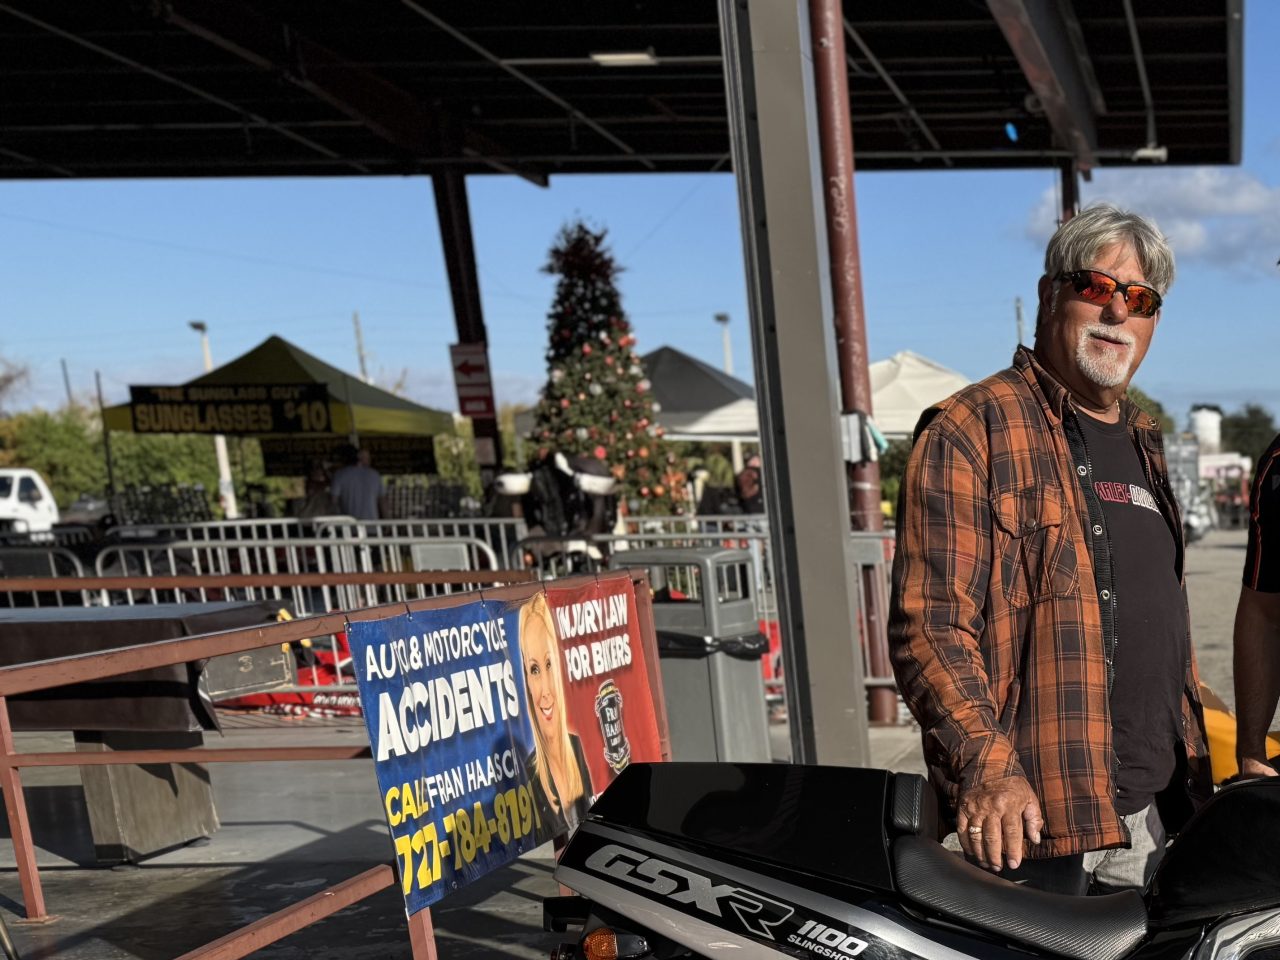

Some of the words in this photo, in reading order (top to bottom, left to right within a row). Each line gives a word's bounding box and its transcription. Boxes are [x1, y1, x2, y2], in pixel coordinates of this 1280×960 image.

[135, 403, 274, 432] SUNGLASSES
[283, 401, 328, 431] $10
[603, 593, 628, 629] LAW
[365, 637, 410, 682] AUTO
[409, 635, 424, 671] &
[423, 617, 508, 668] MOTORCYCLE
[564, 644, 593, 682] FOR
[590, 633, 632, 675] BIKERS
[377, 660, 519, 762] ACCIDENTS
[385, 776, 429, 827] CALL
[425, 766, 465, 808] FRAN
[465, 747, 520, 793] HAASCH
[798, 919, 870, 957] 1100
